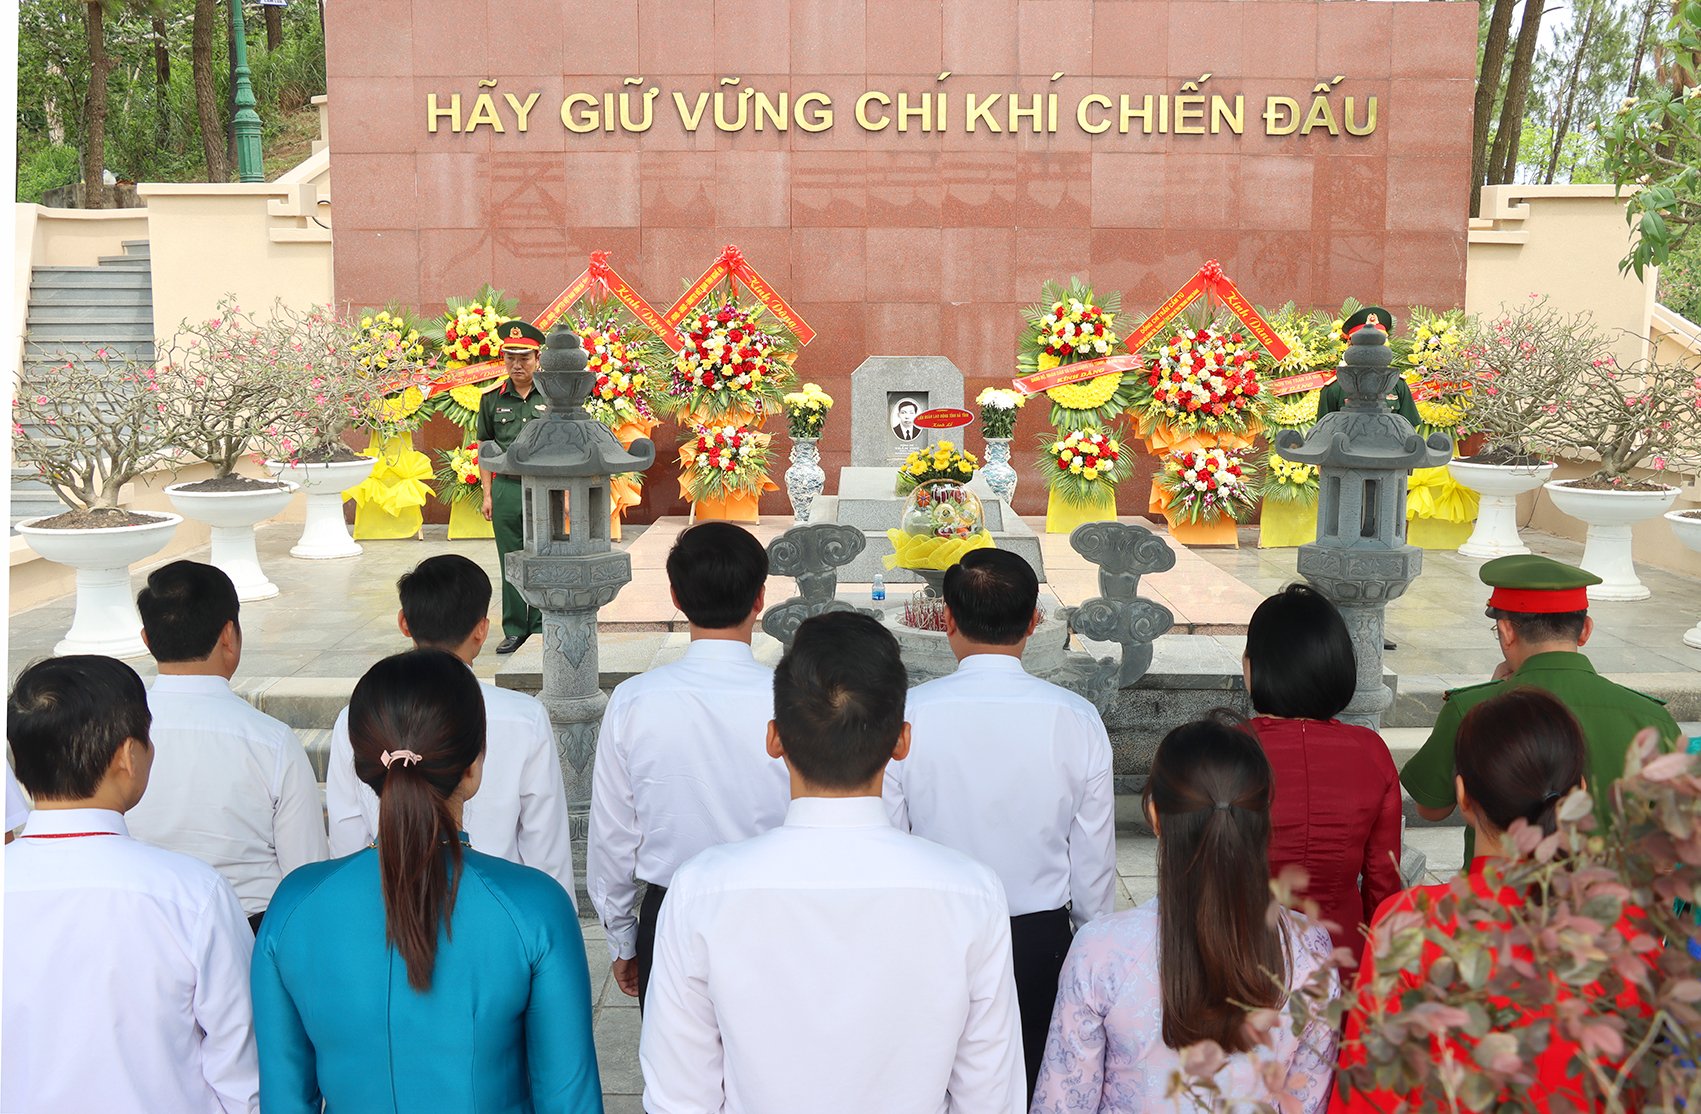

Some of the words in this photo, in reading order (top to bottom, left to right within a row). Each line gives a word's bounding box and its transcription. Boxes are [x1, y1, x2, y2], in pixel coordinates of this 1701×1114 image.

[426, 78, 541, 133] HÃY
[560, 76, 660, 133] GIỮ
[672, 76, 835, 133] VỮNG
[854, 71, 952, 133] CHÍ
[965, 71, 1065, 134] KHÍ
[1076, 73, 1245, 135] CHIẾN
[1262, 75, 1378, 137] ĐẤU
[614, 283, 641, 310] Kính
[641, 308, 668, 337] Dâng
[745, 275, 772, 301] Kính
[770, 300, 797, 328] Dâng
[1222, 290, 1250, 318] Kính
[1248, 316, 1274, 345] Dâng
[1056, 373, 1079, 383] KÍNH
[1080, 367, 1105, 378] DÂNG
